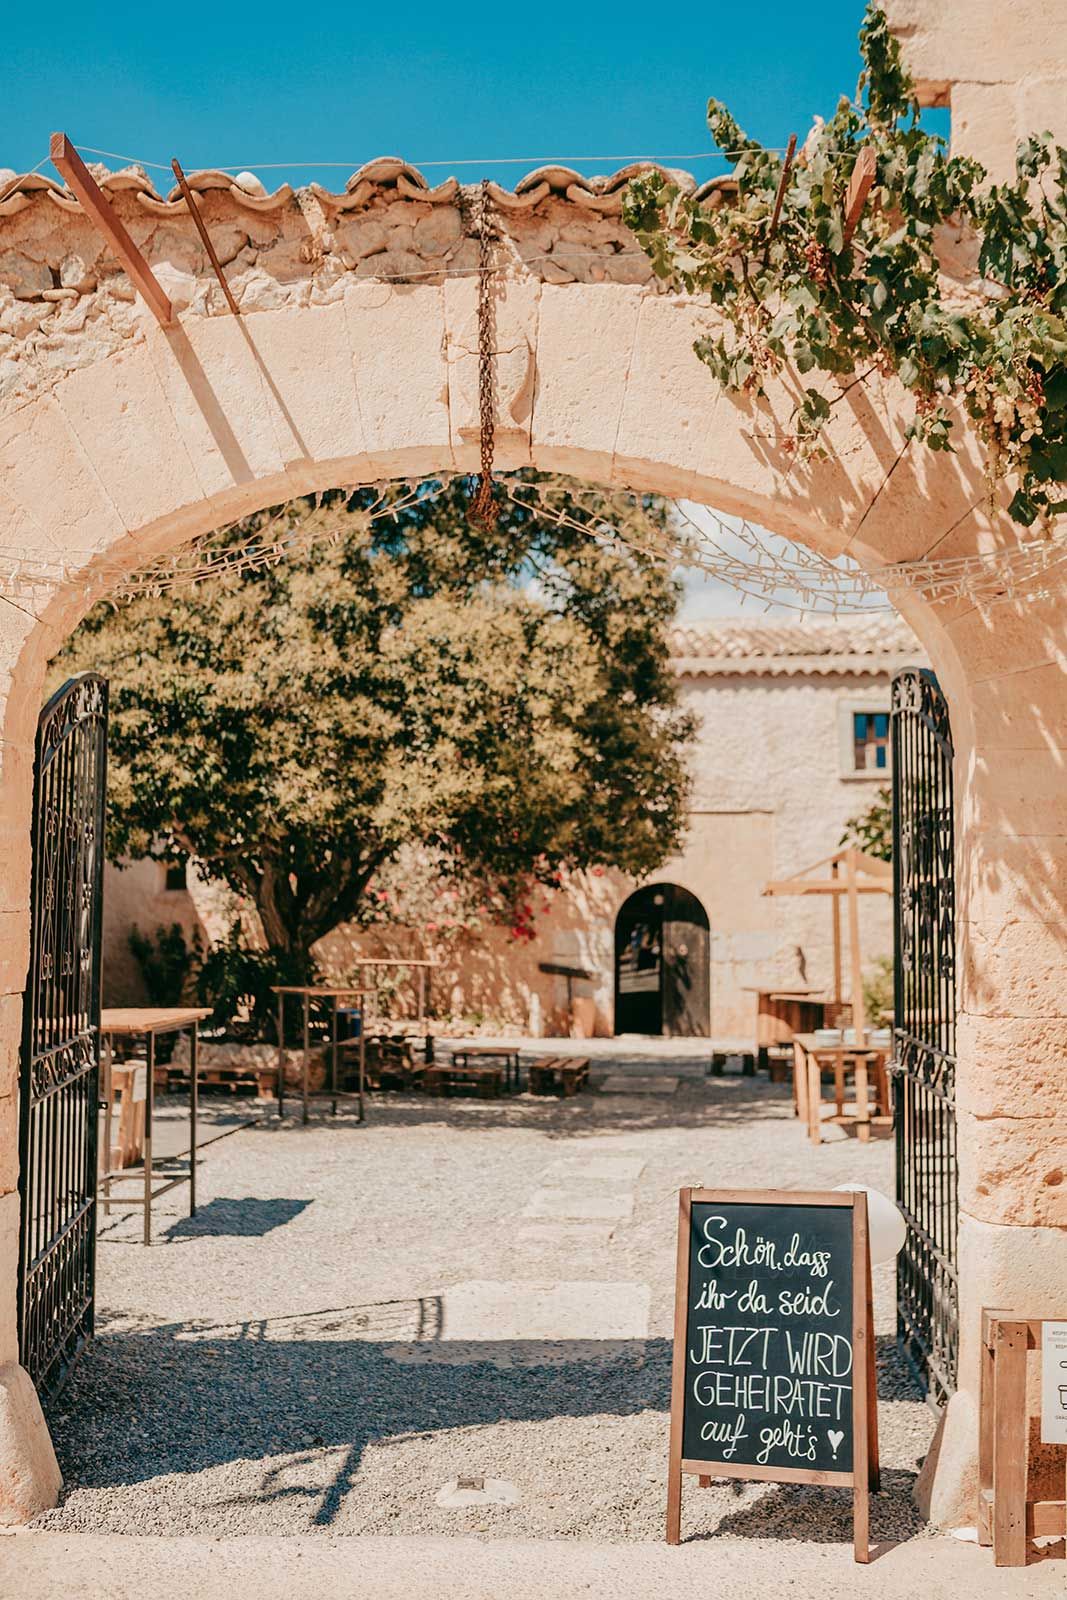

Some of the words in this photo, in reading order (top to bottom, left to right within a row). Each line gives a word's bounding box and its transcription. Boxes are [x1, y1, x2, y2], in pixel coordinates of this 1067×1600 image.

[784, 1233, 831, 1277] dass
[694, 1280, 737, 1312] ihr
[737, 1280, 773, 1314] da
[779, 1281, 840, 1317] seid
[690, 1326, 778, 1369] JETZT
[786, 1331, 853, 1377] WIRD
[694, 1371, 852, 1420] GEHEIRATET
[701, 1414, 749, 1459] auf
